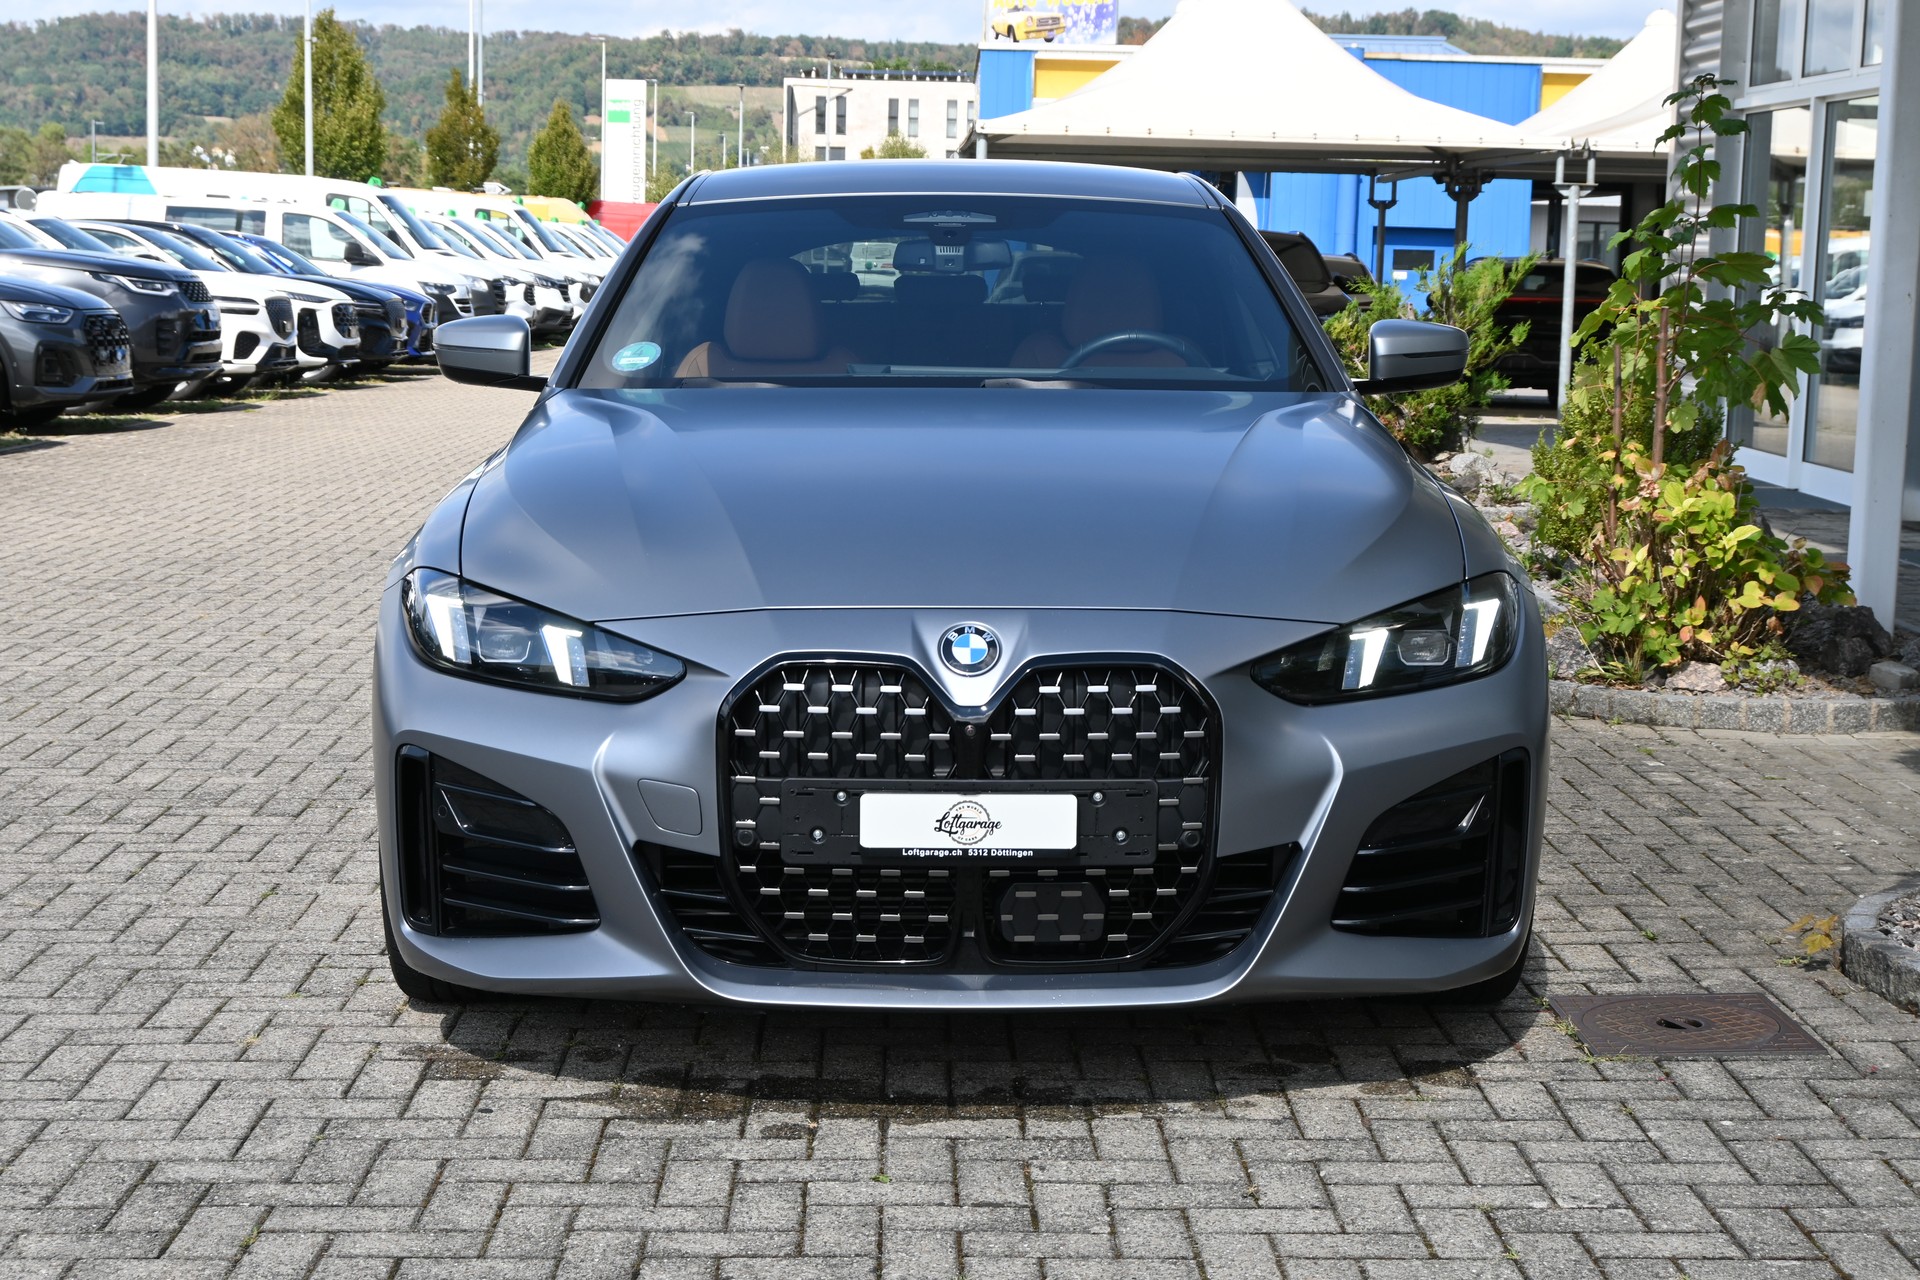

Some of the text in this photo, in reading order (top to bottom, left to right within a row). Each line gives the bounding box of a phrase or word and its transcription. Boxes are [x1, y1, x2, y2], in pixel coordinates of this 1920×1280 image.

[947, 626, 994, 642] BMW
[934, 811, 1002, 837] Loftgarage
[902, 848, 962, 857] Loftgarage.ch
[991, 848, 1033, 858] Döttingen
